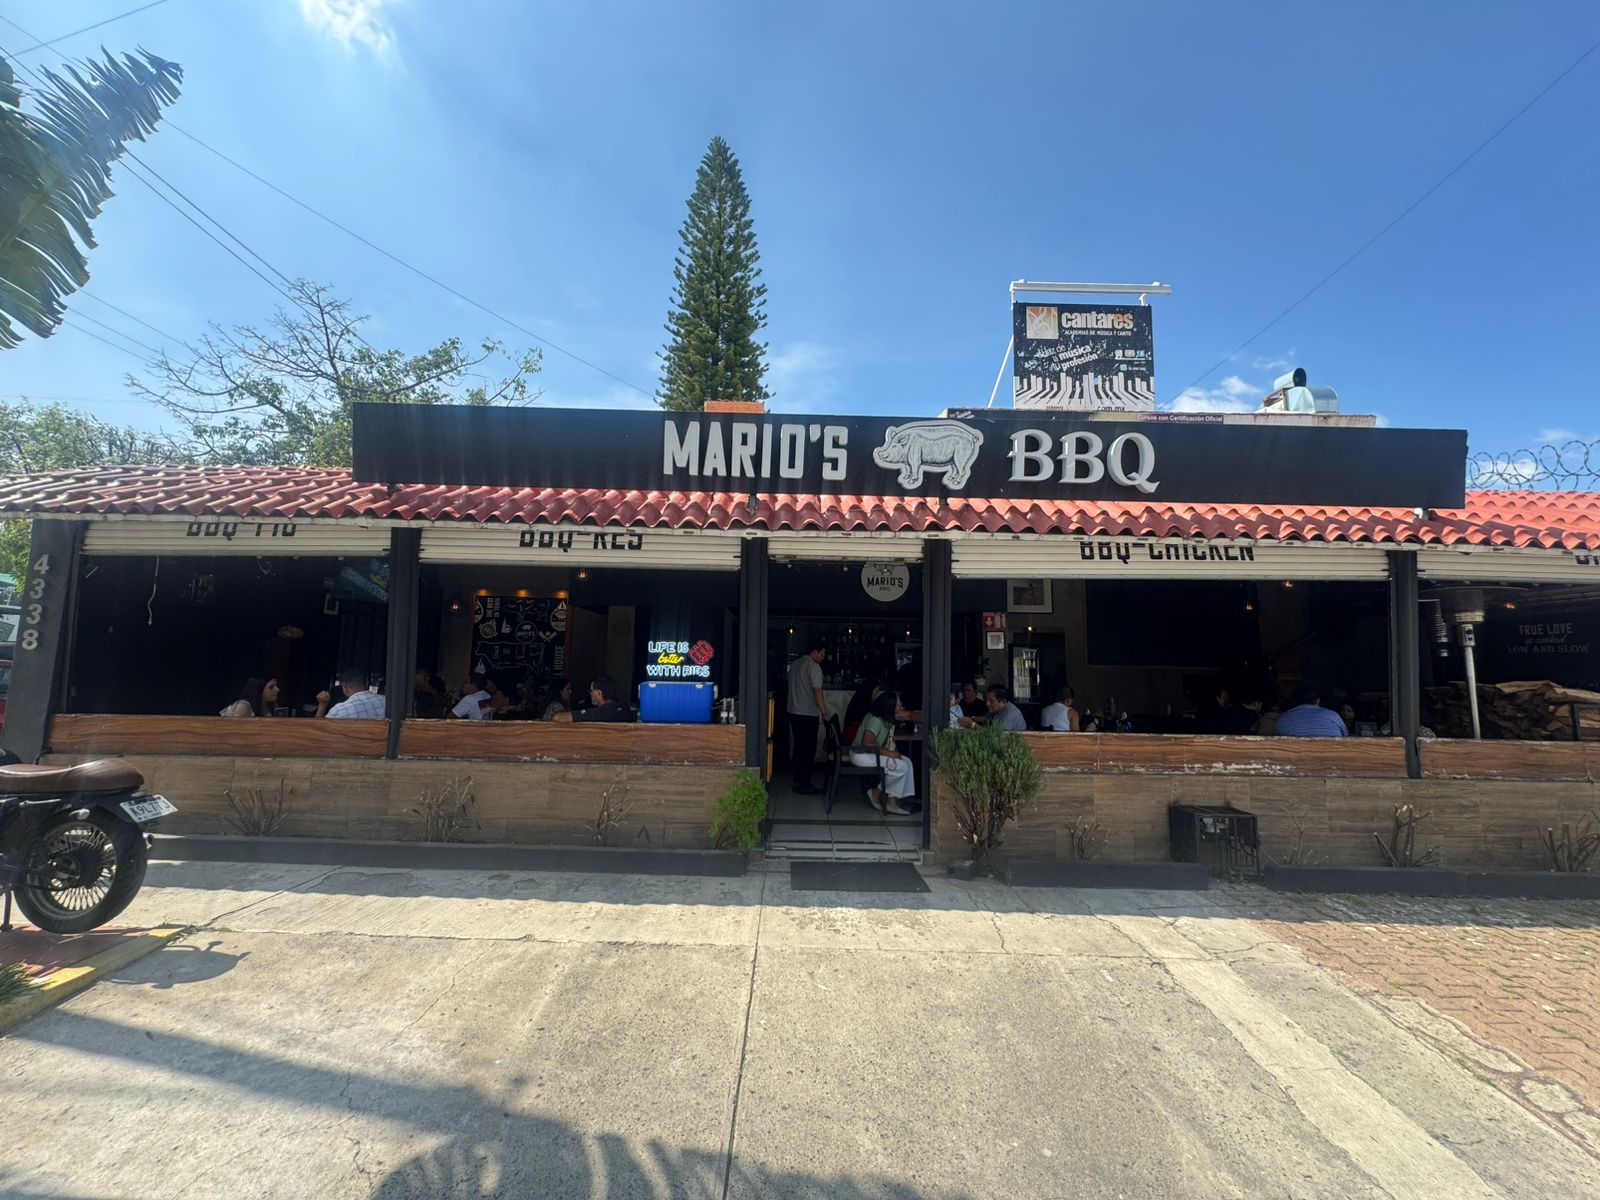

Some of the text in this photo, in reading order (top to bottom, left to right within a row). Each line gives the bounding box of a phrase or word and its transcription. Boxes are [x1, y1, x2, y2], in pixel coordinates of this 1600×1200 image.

[1061, 311, 1134, 329] cantares
[1058, 344, 1092, 360] música
[1061, 353, 1098, 372] profesión
[1169, 414, 1204, 422] Certificación
[663, 420, 1161, 494] MARIO'S BBQ
[1079, 541, 1255, 564] BBQ-CHICKEN
[867, 576, 904, 588] MARIO'S
[21, 553, 50, 651] 4338
[1518, 622, 1573, 635] TRUE LOVE
[648, 641, 689, 653] LIFE IS
[1507, 643, 1590, 654] LOW AND SLOW
[657, 652, 684, 664] better
[646, 665, 710, 677] WITH RIBS
